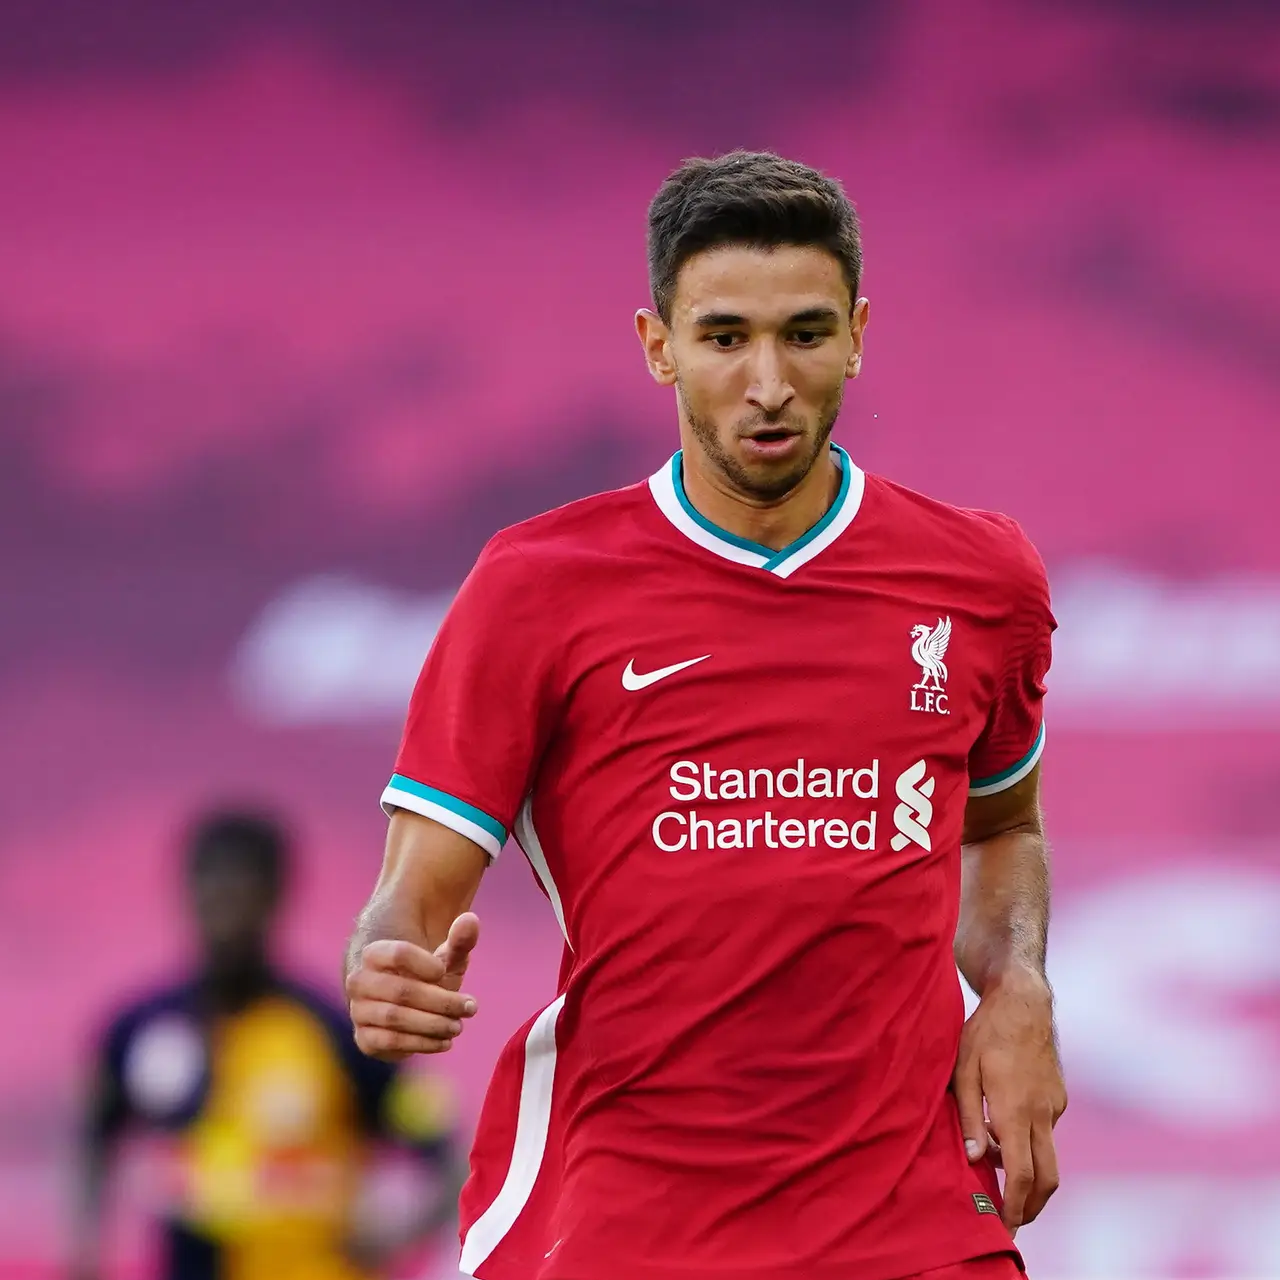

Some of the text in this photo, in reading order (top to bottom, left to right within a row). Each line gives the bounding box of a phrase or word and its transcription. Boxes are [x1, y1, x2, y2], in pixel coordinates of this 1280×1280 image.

[910, 690, 951, 715] L.F.C.
[669, 758, 879, 802] Standard
[652, 811, 877, 852] Chartered
